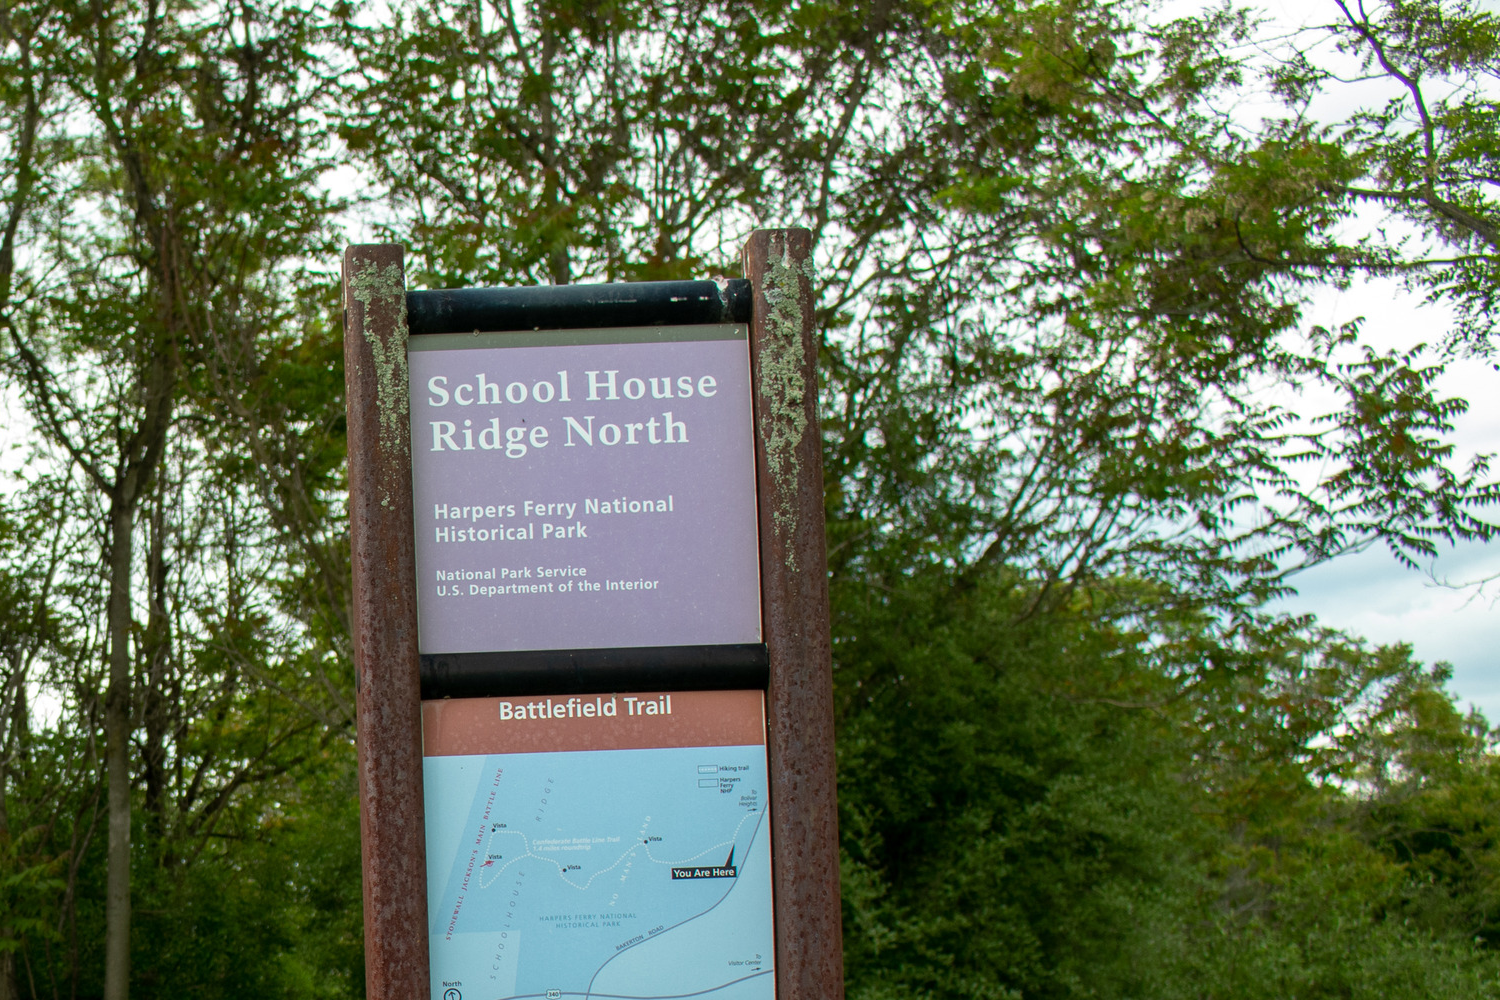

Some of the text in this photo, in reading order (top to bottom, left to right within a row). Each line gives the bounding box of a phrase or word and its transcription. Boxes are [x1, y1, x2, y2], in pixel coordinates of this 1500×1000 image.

[427, 369, 718, 407] School House
[429, 411, 690, 459] Ridge North
[434, 495, 674, 522] Harpers Ferry National
[435, 522, 588, 543] Historical Park
[436, 565, 587, 581] National Park Service
[436, 578, 659, 598] U.S. Department of the Interior
[500, 695, 672, 721] Battlefield Trail
[535, 777, 554, 822] RIDGE
[445, 768, 503, 941] STONEWALL JACKSON'S MAIN BATTLE LINE
[673, 868, 735, 878] You Are Here
[615, 925, 665, 951] BAKERTON ROAD
